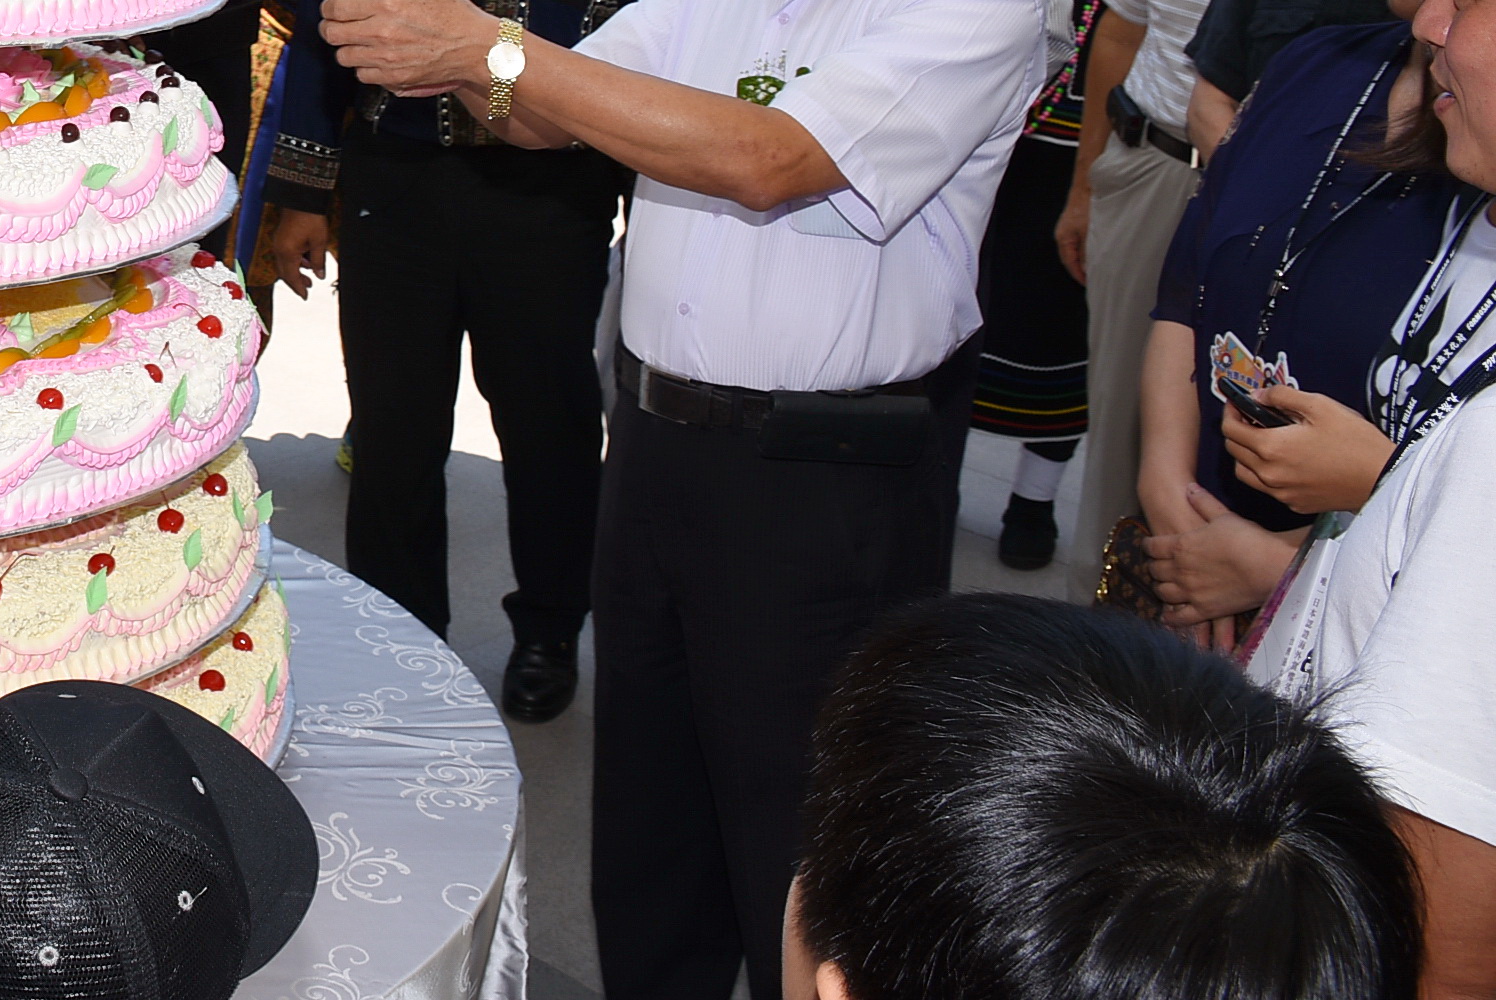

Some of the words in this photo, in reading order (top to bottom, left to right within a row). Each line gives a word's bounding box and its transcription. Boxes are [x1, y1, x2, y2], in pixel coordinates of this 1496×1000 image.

[1407, 294, 1431, 338] 九族文化村
[1465, 298, 1494, 331] FORMOSAN
[1430, 332, 1467, 374] 九族文化村
[1401, 396, 1418, 424] VILLAGE
[1415, 391, 1460, 437] 九族文化村
